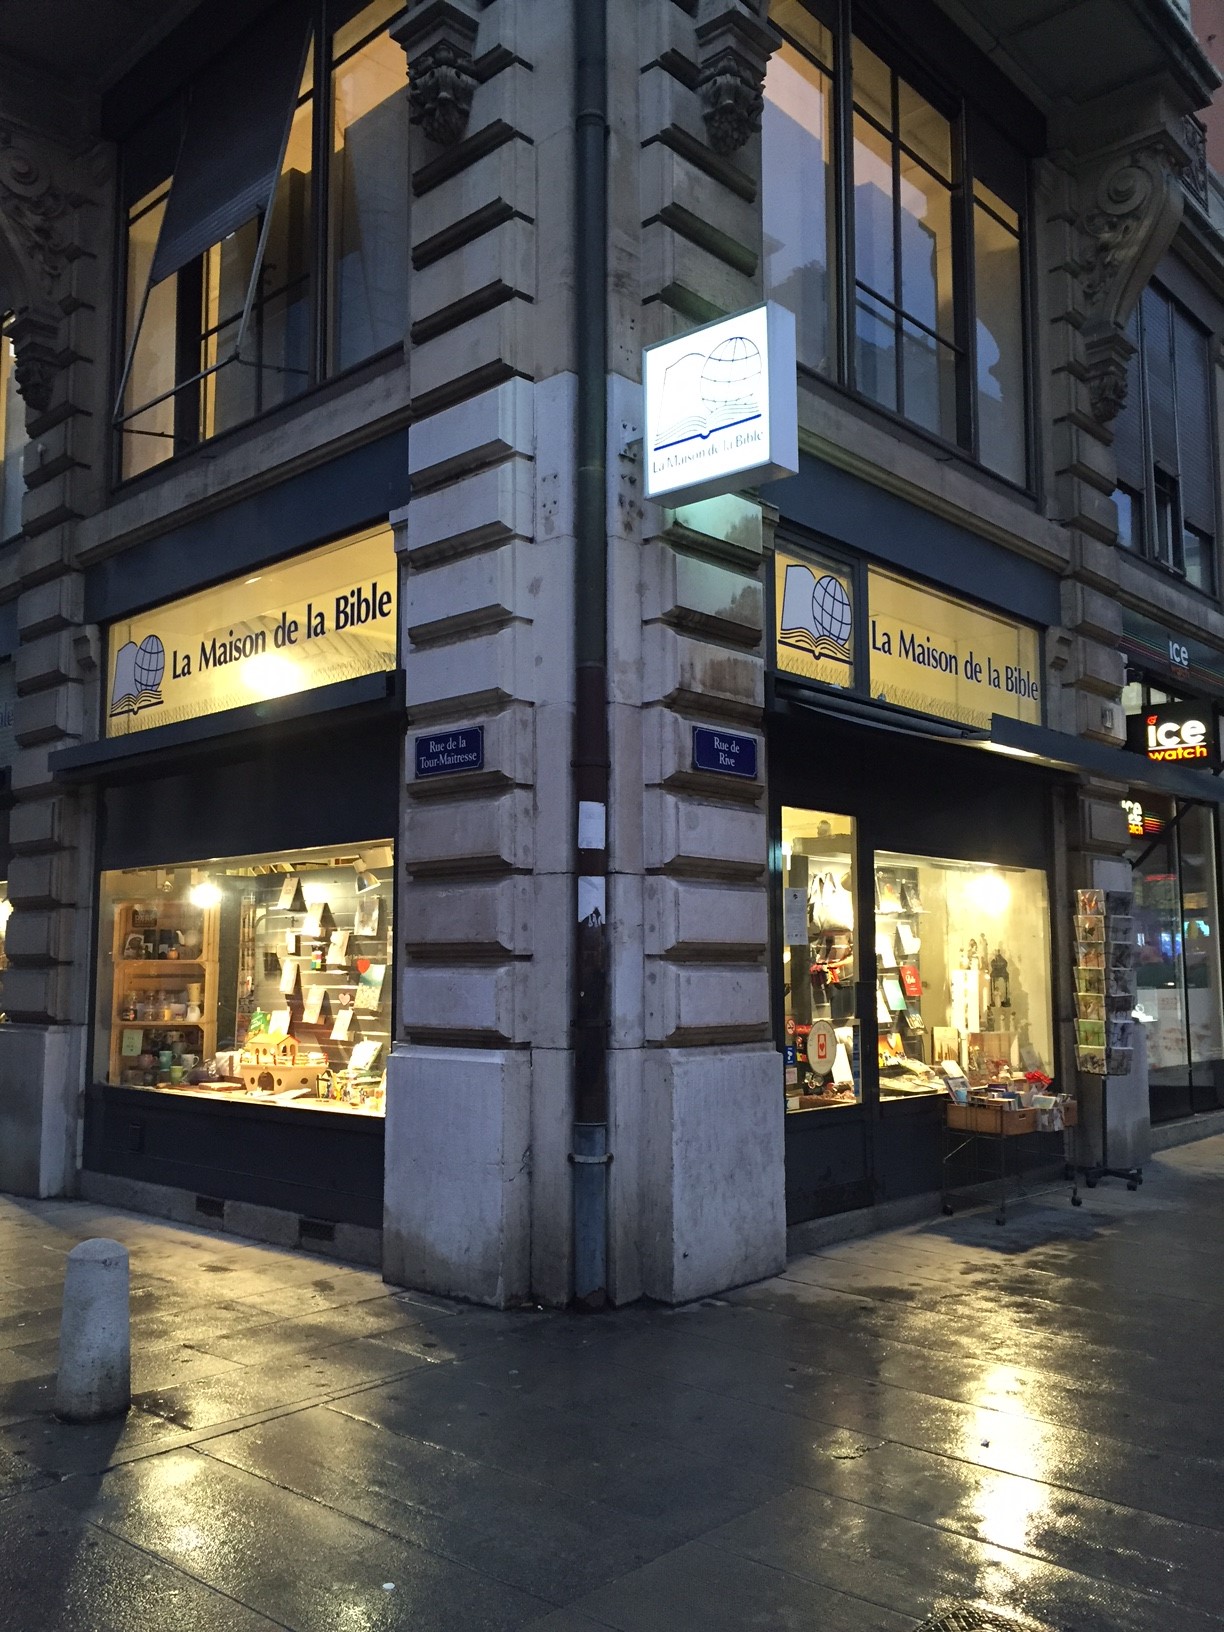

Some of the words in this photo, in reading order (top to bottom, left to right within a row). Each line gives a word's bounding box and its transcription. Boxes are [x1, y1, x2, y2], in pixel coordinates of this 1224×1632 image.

[653, 461, 665, 473] La
[172, 649, 192, 680] La
[198, 629, 267, 672] Maison
[274, 611, 299, 648] de
[306, 603, 326, 640] la
[335, 581, 393, 631] Bible
[871, 619, 893, 656] La
[899, 629, 959, 676] Maison
[964, 650, 982, 683] de
[987, 656, 1001, 689] la
[1005, 665, 1039, 701] Bible
[1147, 715, 1207, 747] ice
[430, 741, 445, 752] Rue
[447, 738, 456, 750] de
[459, 735, 466, 748] la
[714, 736, 729, 751] Rue
[730, 740, 740, 753] de
[420, 752, 477, 769] Tour-Maîtresse
[719, 752, 736, 767] Rive
[1149, 746, 1207, 761] watch
